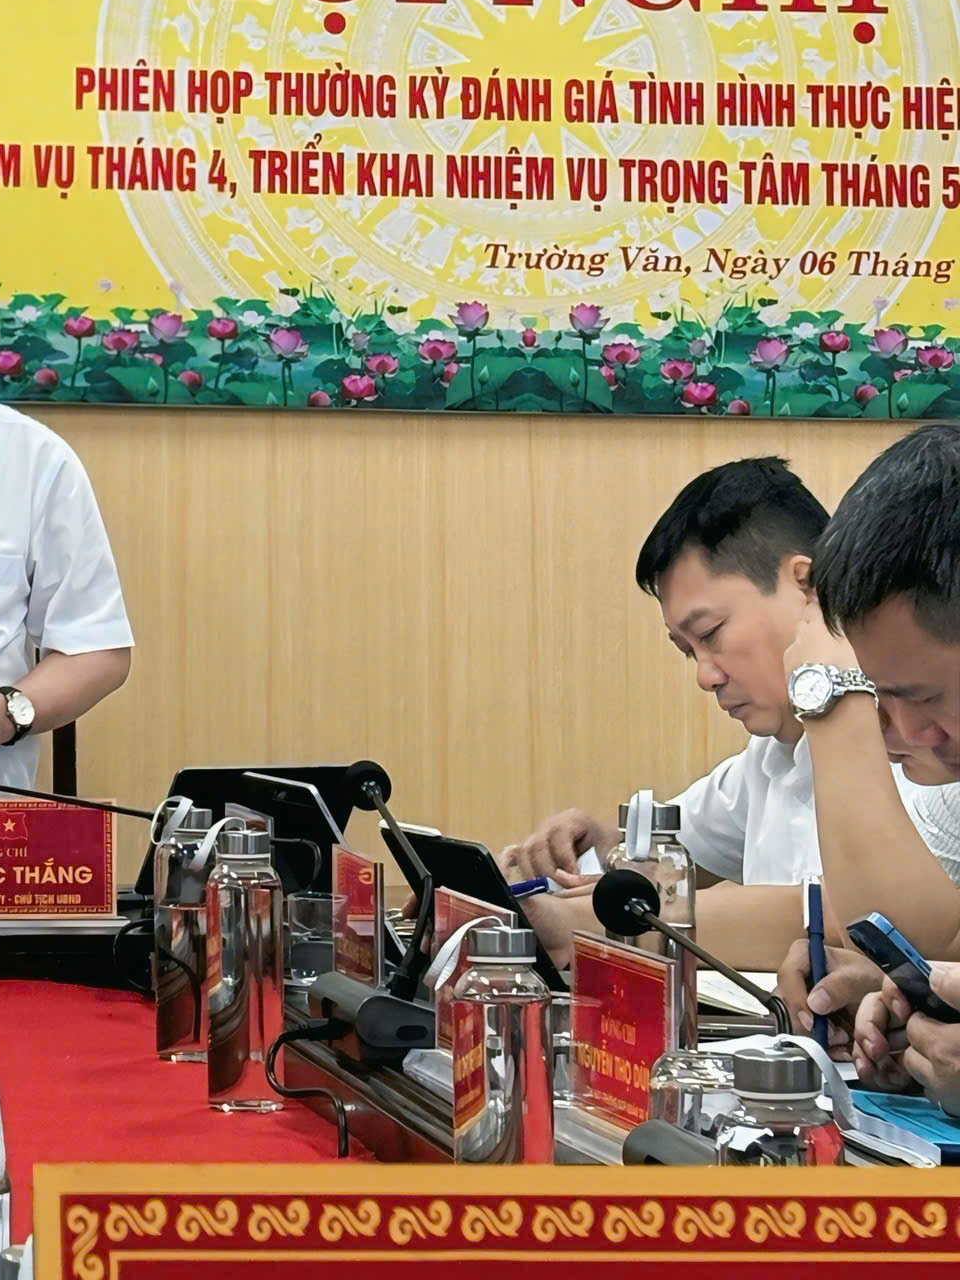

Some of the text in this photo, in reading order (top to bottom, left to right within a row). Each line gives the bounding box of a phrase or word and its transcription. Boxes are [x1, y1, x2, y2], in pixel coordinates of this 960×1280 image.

[75, 59, 960, 141] PHIÊN HỌP THƯỜNG KỲ ĐÁNH GIÁ TÌNH HÌNH THỰC HIỆ
[33, 144, 75, 199] VỤ
[86, 138, 197, 192] THÁNG
[208, 149, 237, 199] 4,
[248, 133, 345, 196] TRIỂN
[357, 152, 434, 197] KHAI
[446, 147, 555, 210] NHIỆM
[566, 157, 608, 212] VỤ
[618, 159, 728, 213] TRỌNG
[739, 152, 810, 206] TÂM
[821, 154, 930, 209] THÁNG
[942, 166, 960, 209] 5
[484, 243, 956, 284] Trường Văn, Ngày 06 Tháng
[12, 857, 93, 885] THẮNG
